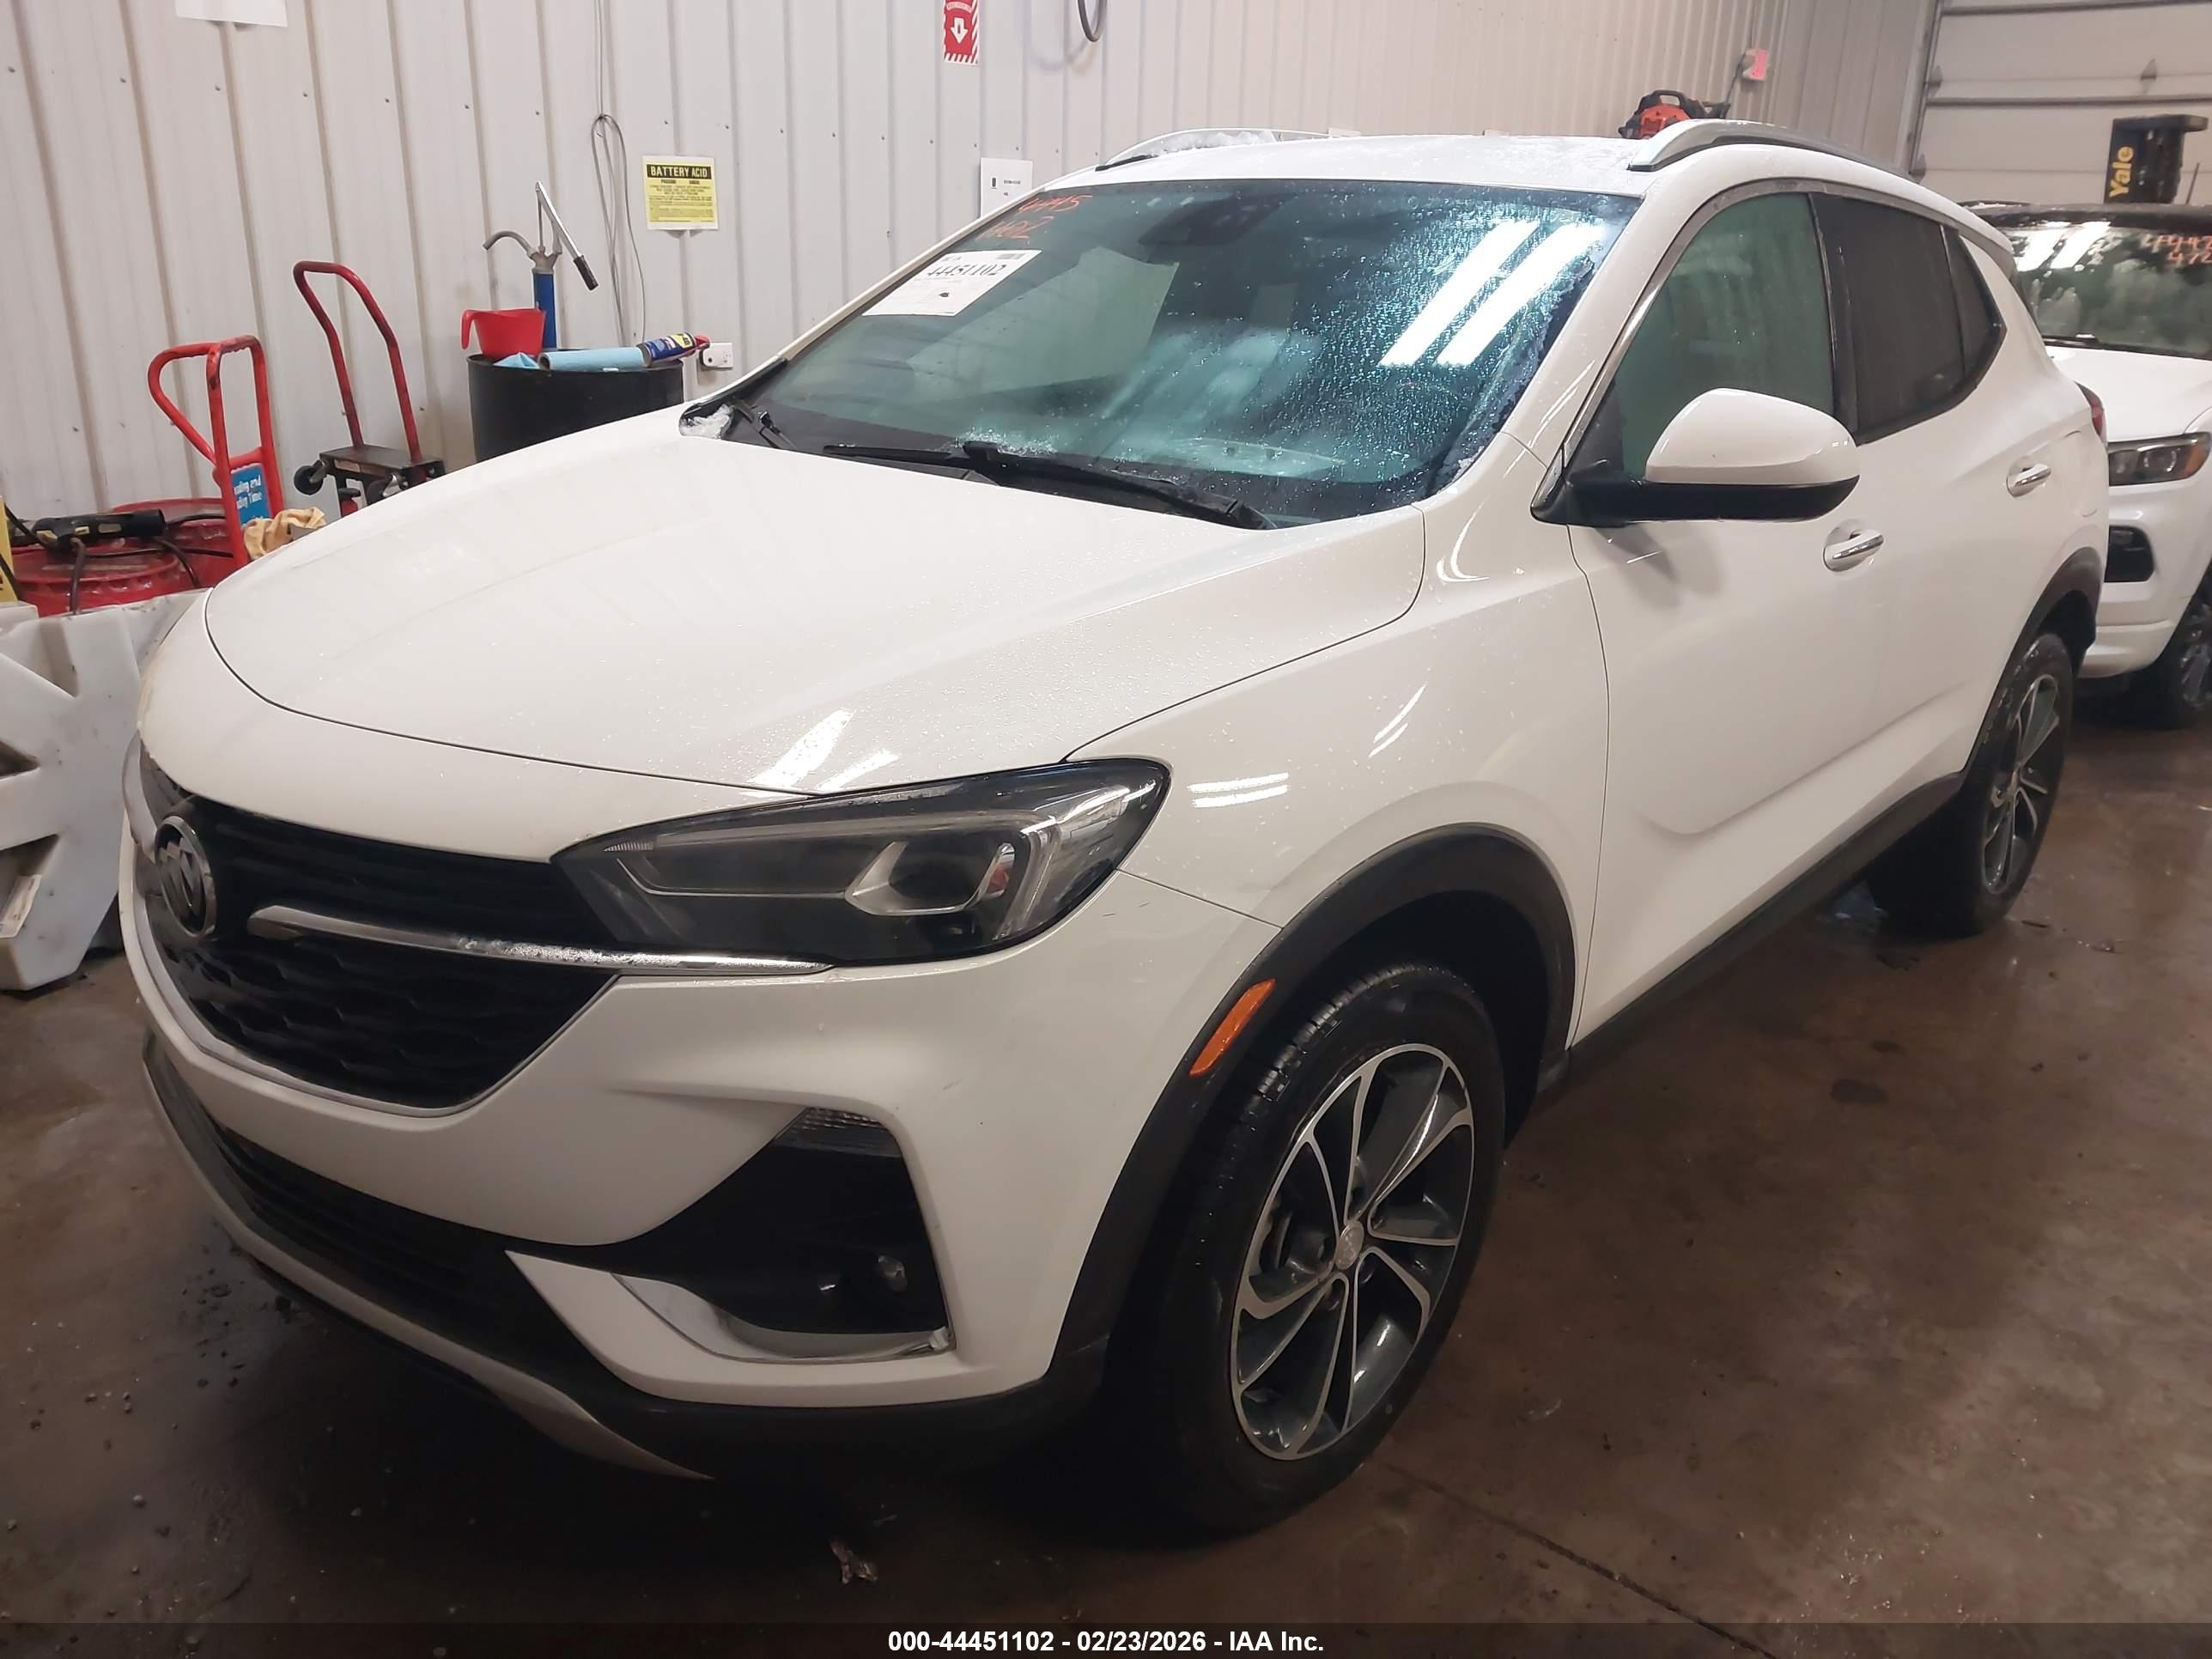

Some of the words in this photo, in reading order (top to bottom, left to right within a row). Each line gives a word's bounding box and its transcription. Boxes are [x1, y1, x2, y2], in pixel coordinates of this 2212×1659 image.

[650, 166, 690, 178] BATTERY
[691, 167, 708, 179] ACID
[2109, 146, 2135, 198] Yale
[927, 264, 1007, 276] 44451102
